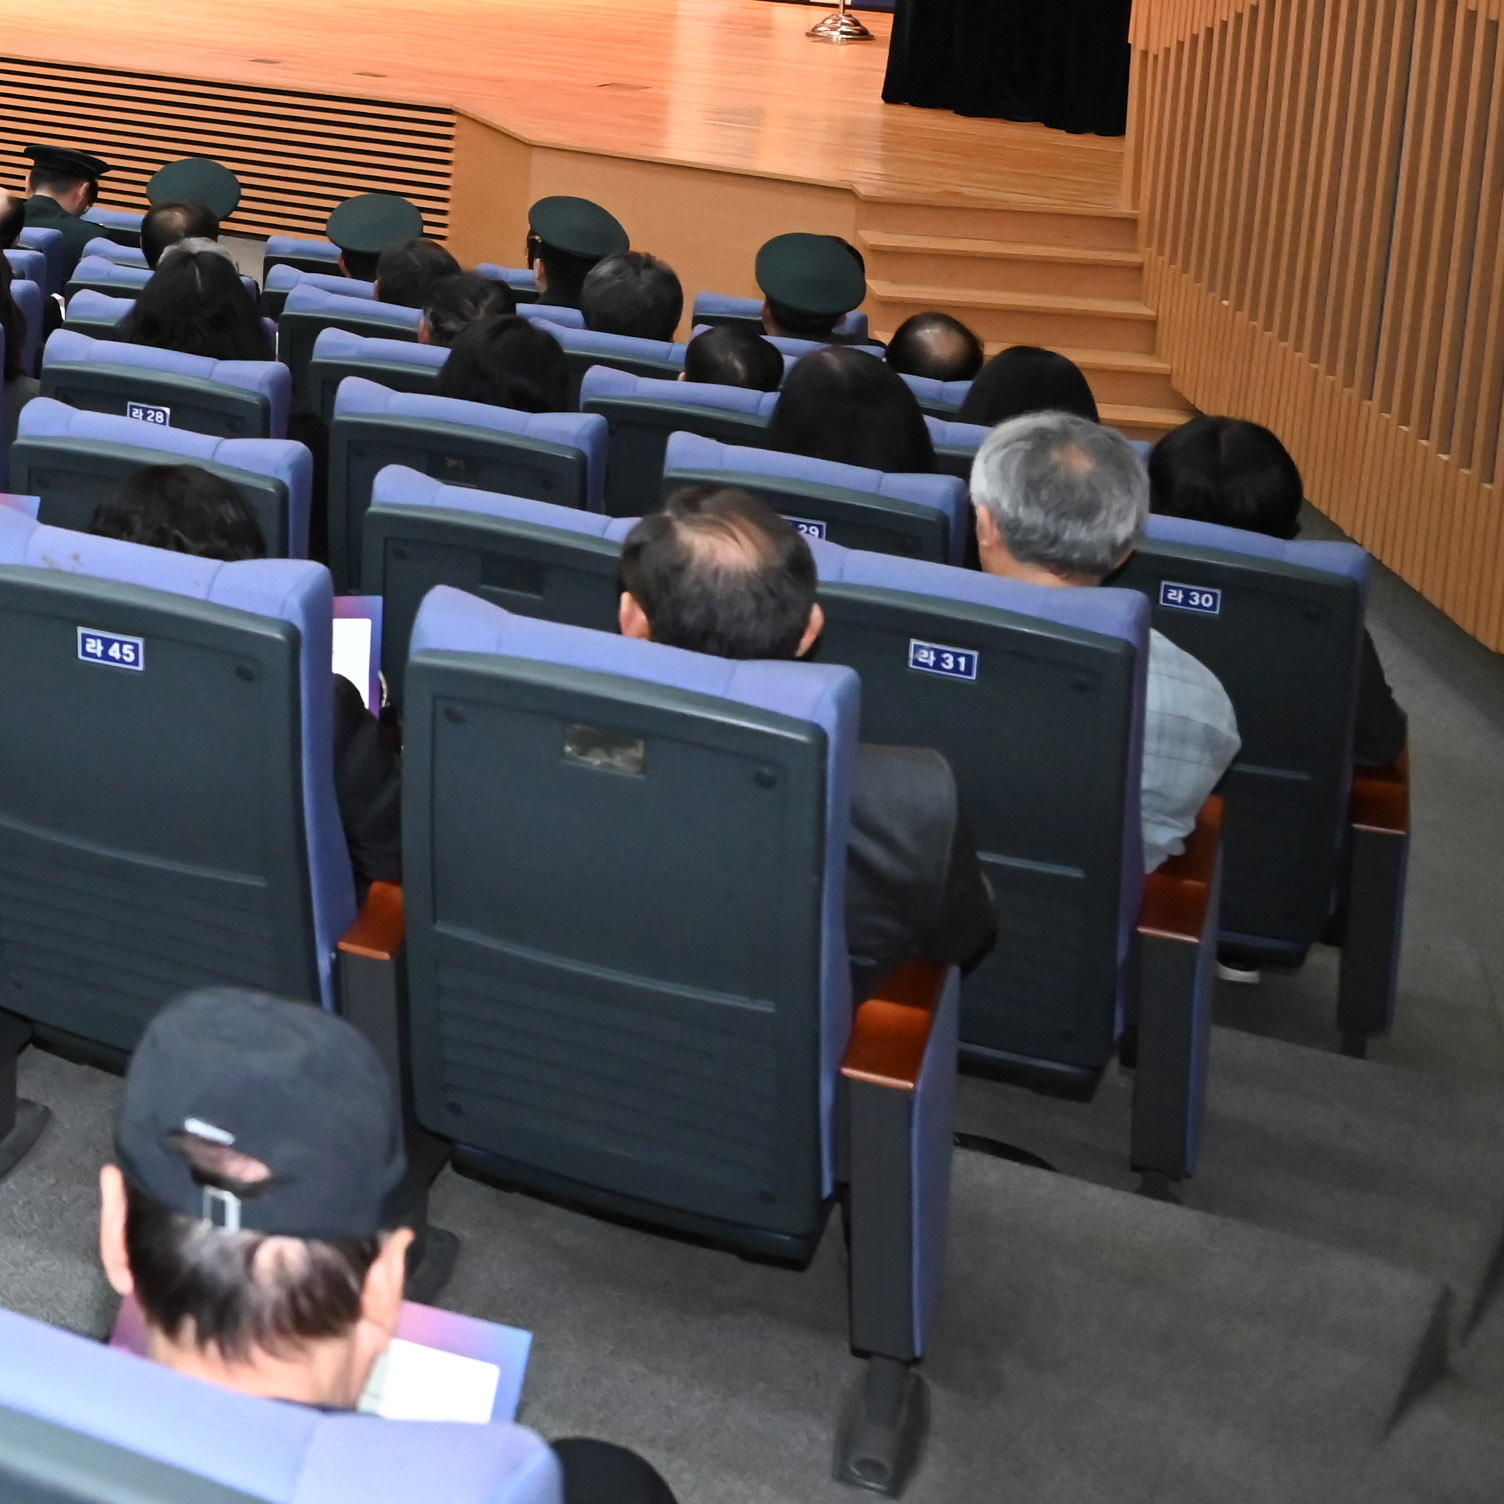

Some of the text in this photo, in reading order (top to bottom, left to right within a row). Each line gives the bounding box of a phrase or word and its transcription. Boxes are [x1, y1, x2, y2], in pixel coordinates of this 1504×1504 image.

[132, 407, 164, 423] 라 28
[798, 523, 820, 538] 29
[1167, 589, 1213, 607] 라 30
[85, 637, 135, 662] 라 45
[917, 649, 966, 672] 라 31
